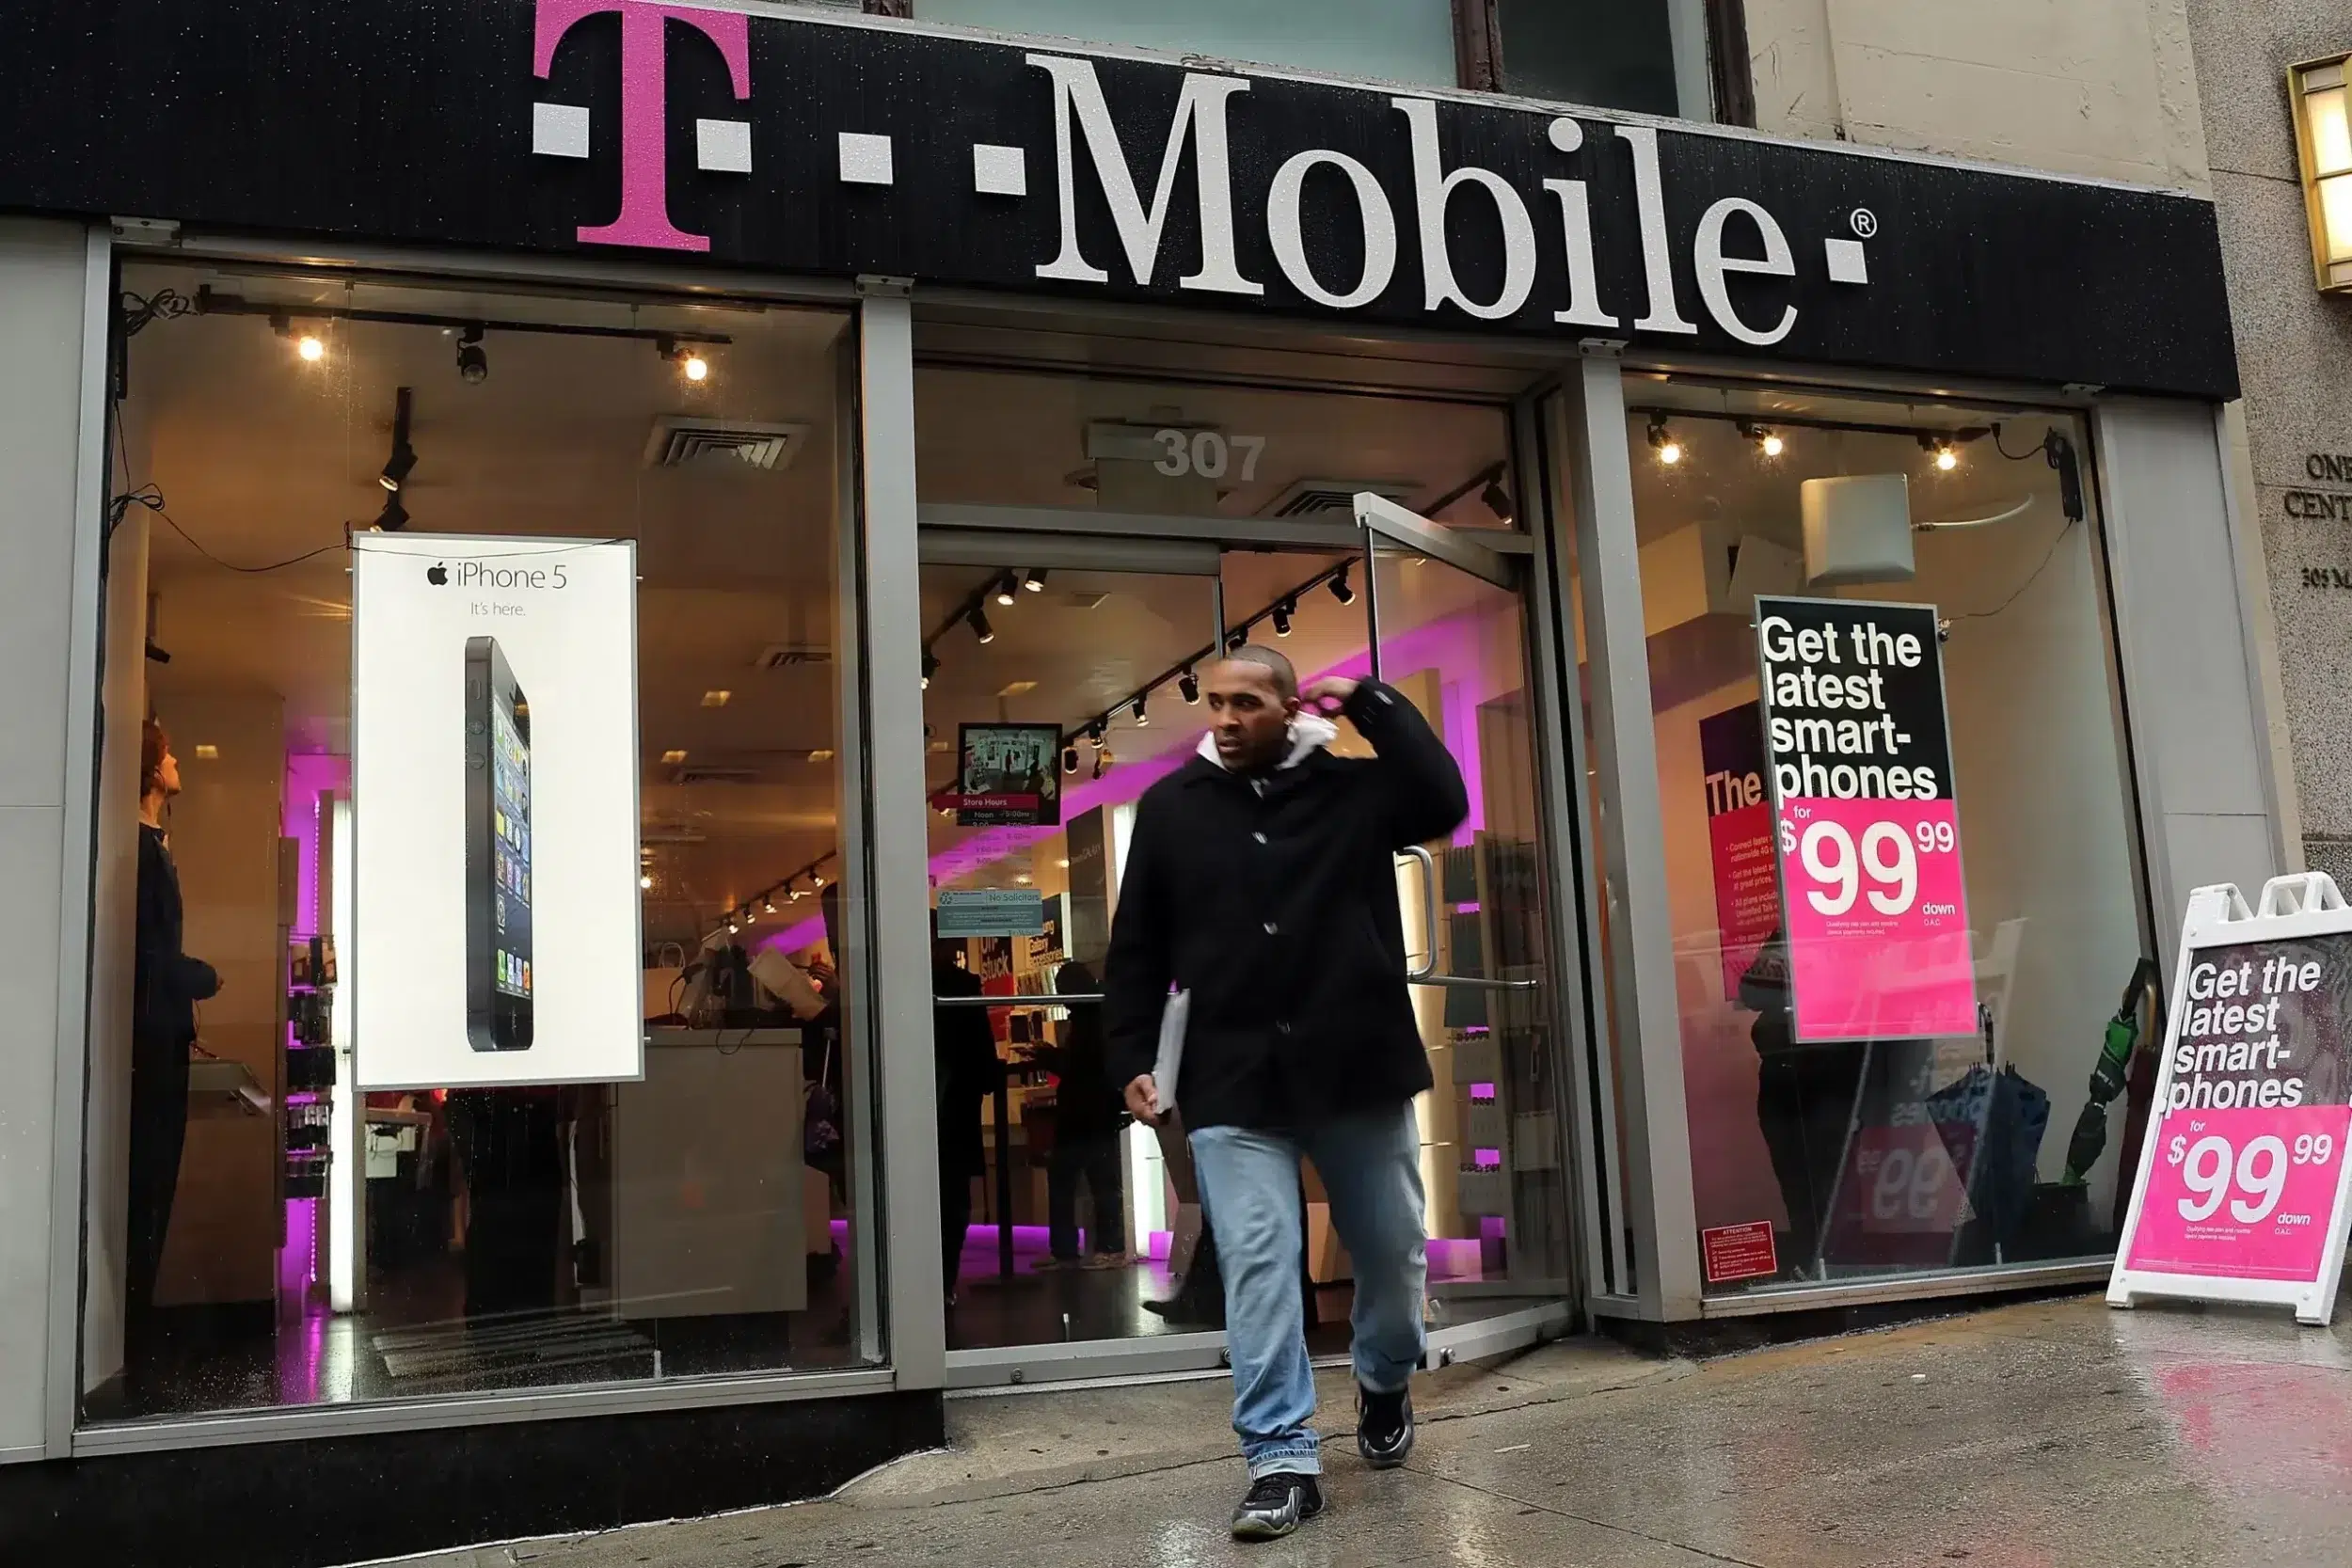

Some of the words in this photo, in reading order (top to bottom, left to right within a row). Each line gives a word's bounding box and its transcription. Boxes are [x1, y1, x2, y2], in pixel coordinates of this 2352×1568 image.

[1153, 429, 1266, 482] 307
[457, 562, 546, 589] iPhone
[552, 564, 567, 590] 5
[470, 602, 488, 616] It's
[492, 602, 526, 617] here.
[1760, 615, 1840, 664] Get
[1851, 622, 1922, 667] the
[1766, 662, 1885, 709] latest
[1769, 713, 1911, 754] smart-
[1706, 769, 1762, 816] The
[1774, 753, 1938, 810] phones
[963, 798, 983, 806] Store
[984, 798, 1008, 806] Hours
[1793, 804, 1811, 819] for
[990, 894, 1001, 902] No
[1003, 892, 1040, 902] Solicitors
[1922, 901, 1956, 915] down
[981, 949, 1009, 985] stuck
[2188, 961, 2252, 1001] Get
[2263, 956, 2321, 993] the
[2181, 995, 2280, 1037] latest
[2174, 1035, 2290, 1073] smart-
[2165, 1073, 2303, 1120] phones
[2189, 1119, 2206, 1132] for
[1722, 1226, 1753, 1236] ATTENTION
[2277, 1212, 2311, 1227] down
